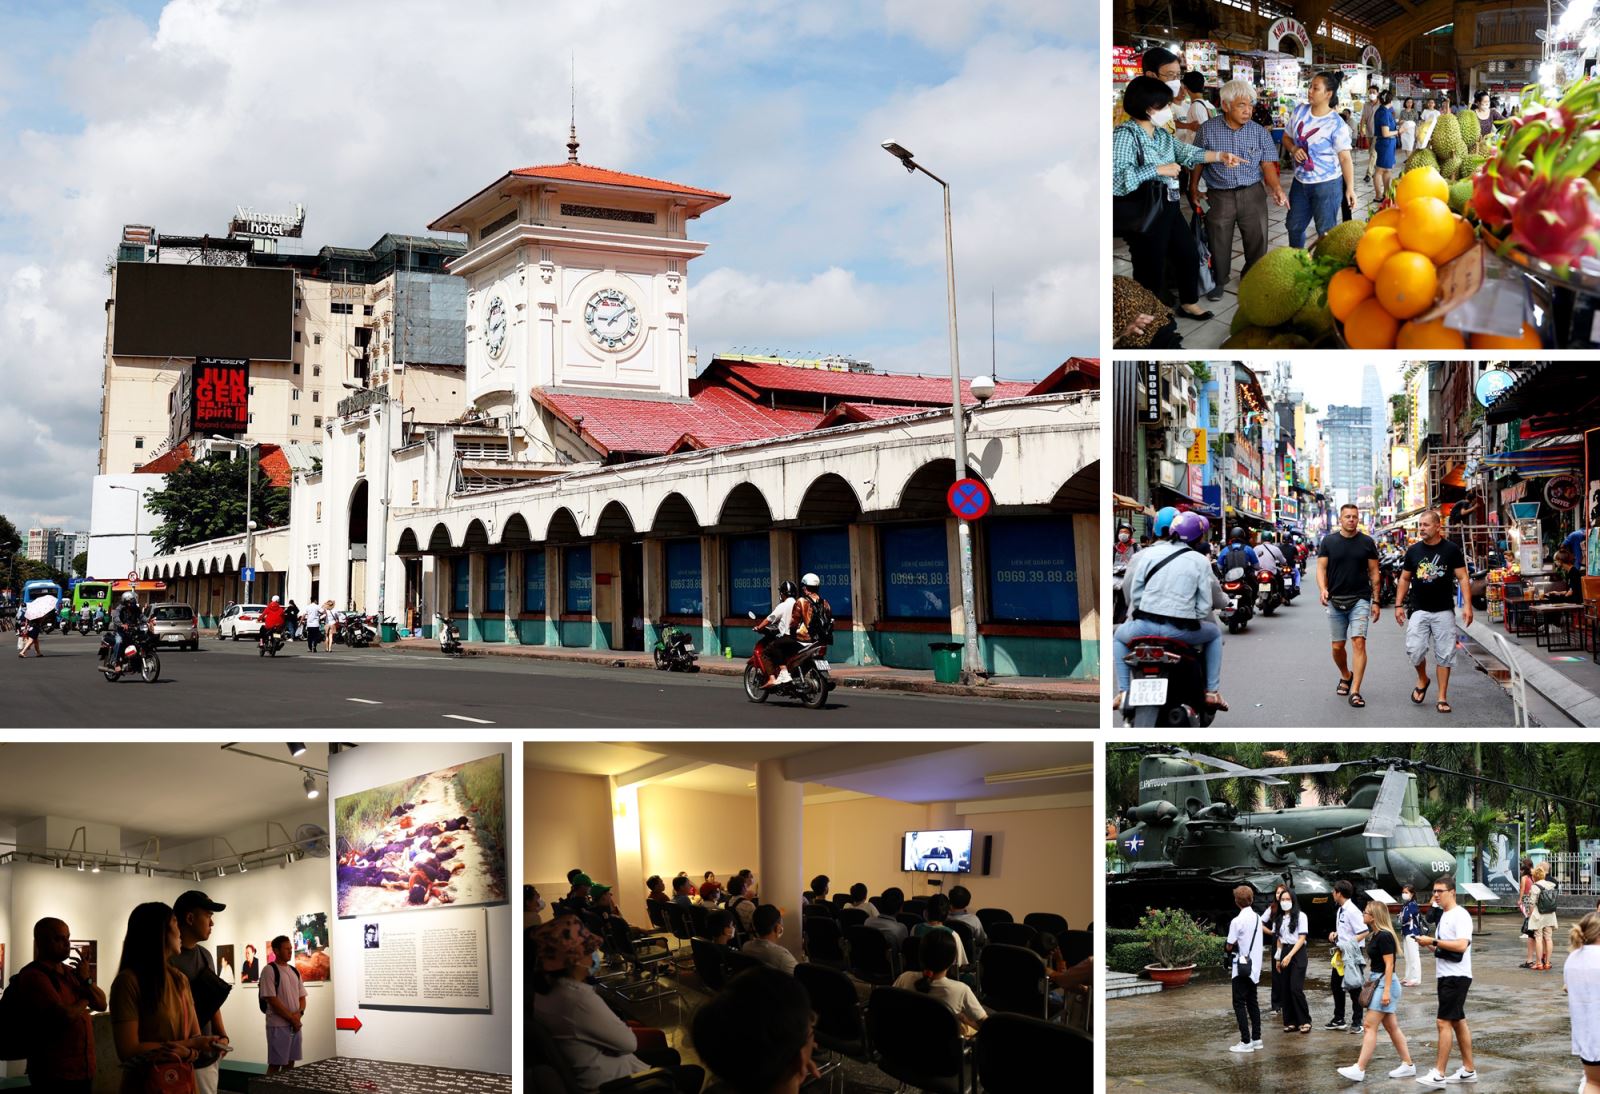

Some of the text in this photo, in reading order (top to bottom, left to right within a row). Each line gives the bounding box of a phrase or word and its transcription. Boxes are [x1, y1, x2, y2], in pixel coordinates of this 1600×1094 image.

[250, 221, 284, 236] hotel
[1149, 375, 1157, 396] DOG
[1149, 399, 1158, 419] BAR
[1431, 860, 1450, 872] 086
